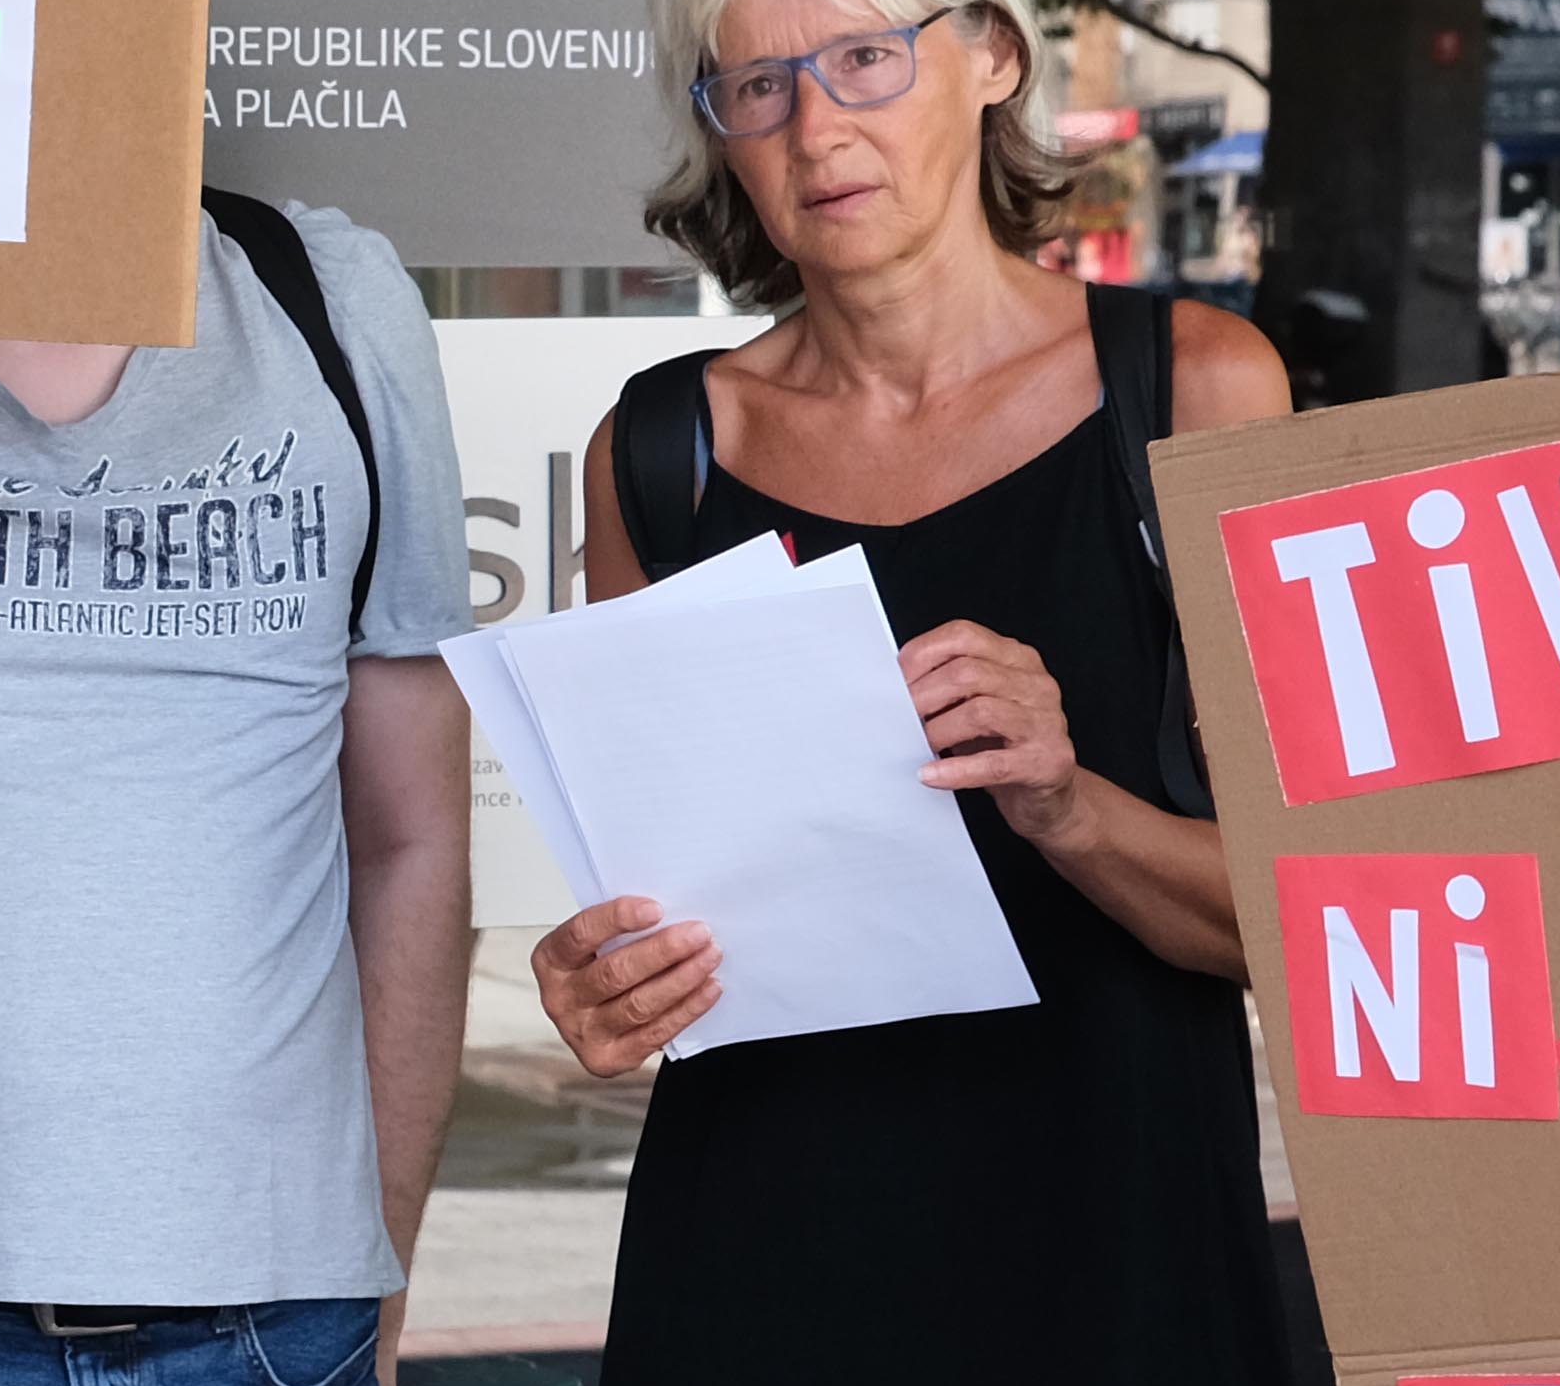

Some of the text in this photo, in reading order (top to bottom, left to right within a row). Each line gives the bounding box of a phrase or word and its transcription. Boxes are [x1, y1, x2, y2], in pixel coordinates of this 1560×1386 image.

[209, 26, 655, 78] REPUBLIKE SLOVENIJ
[236, 79, 407, 129] PLAČILA
[102, 483, 328, 592] BEACH
[141, 599, 242, 638] JET-SET
[253, 594, 307, 633] ROW
